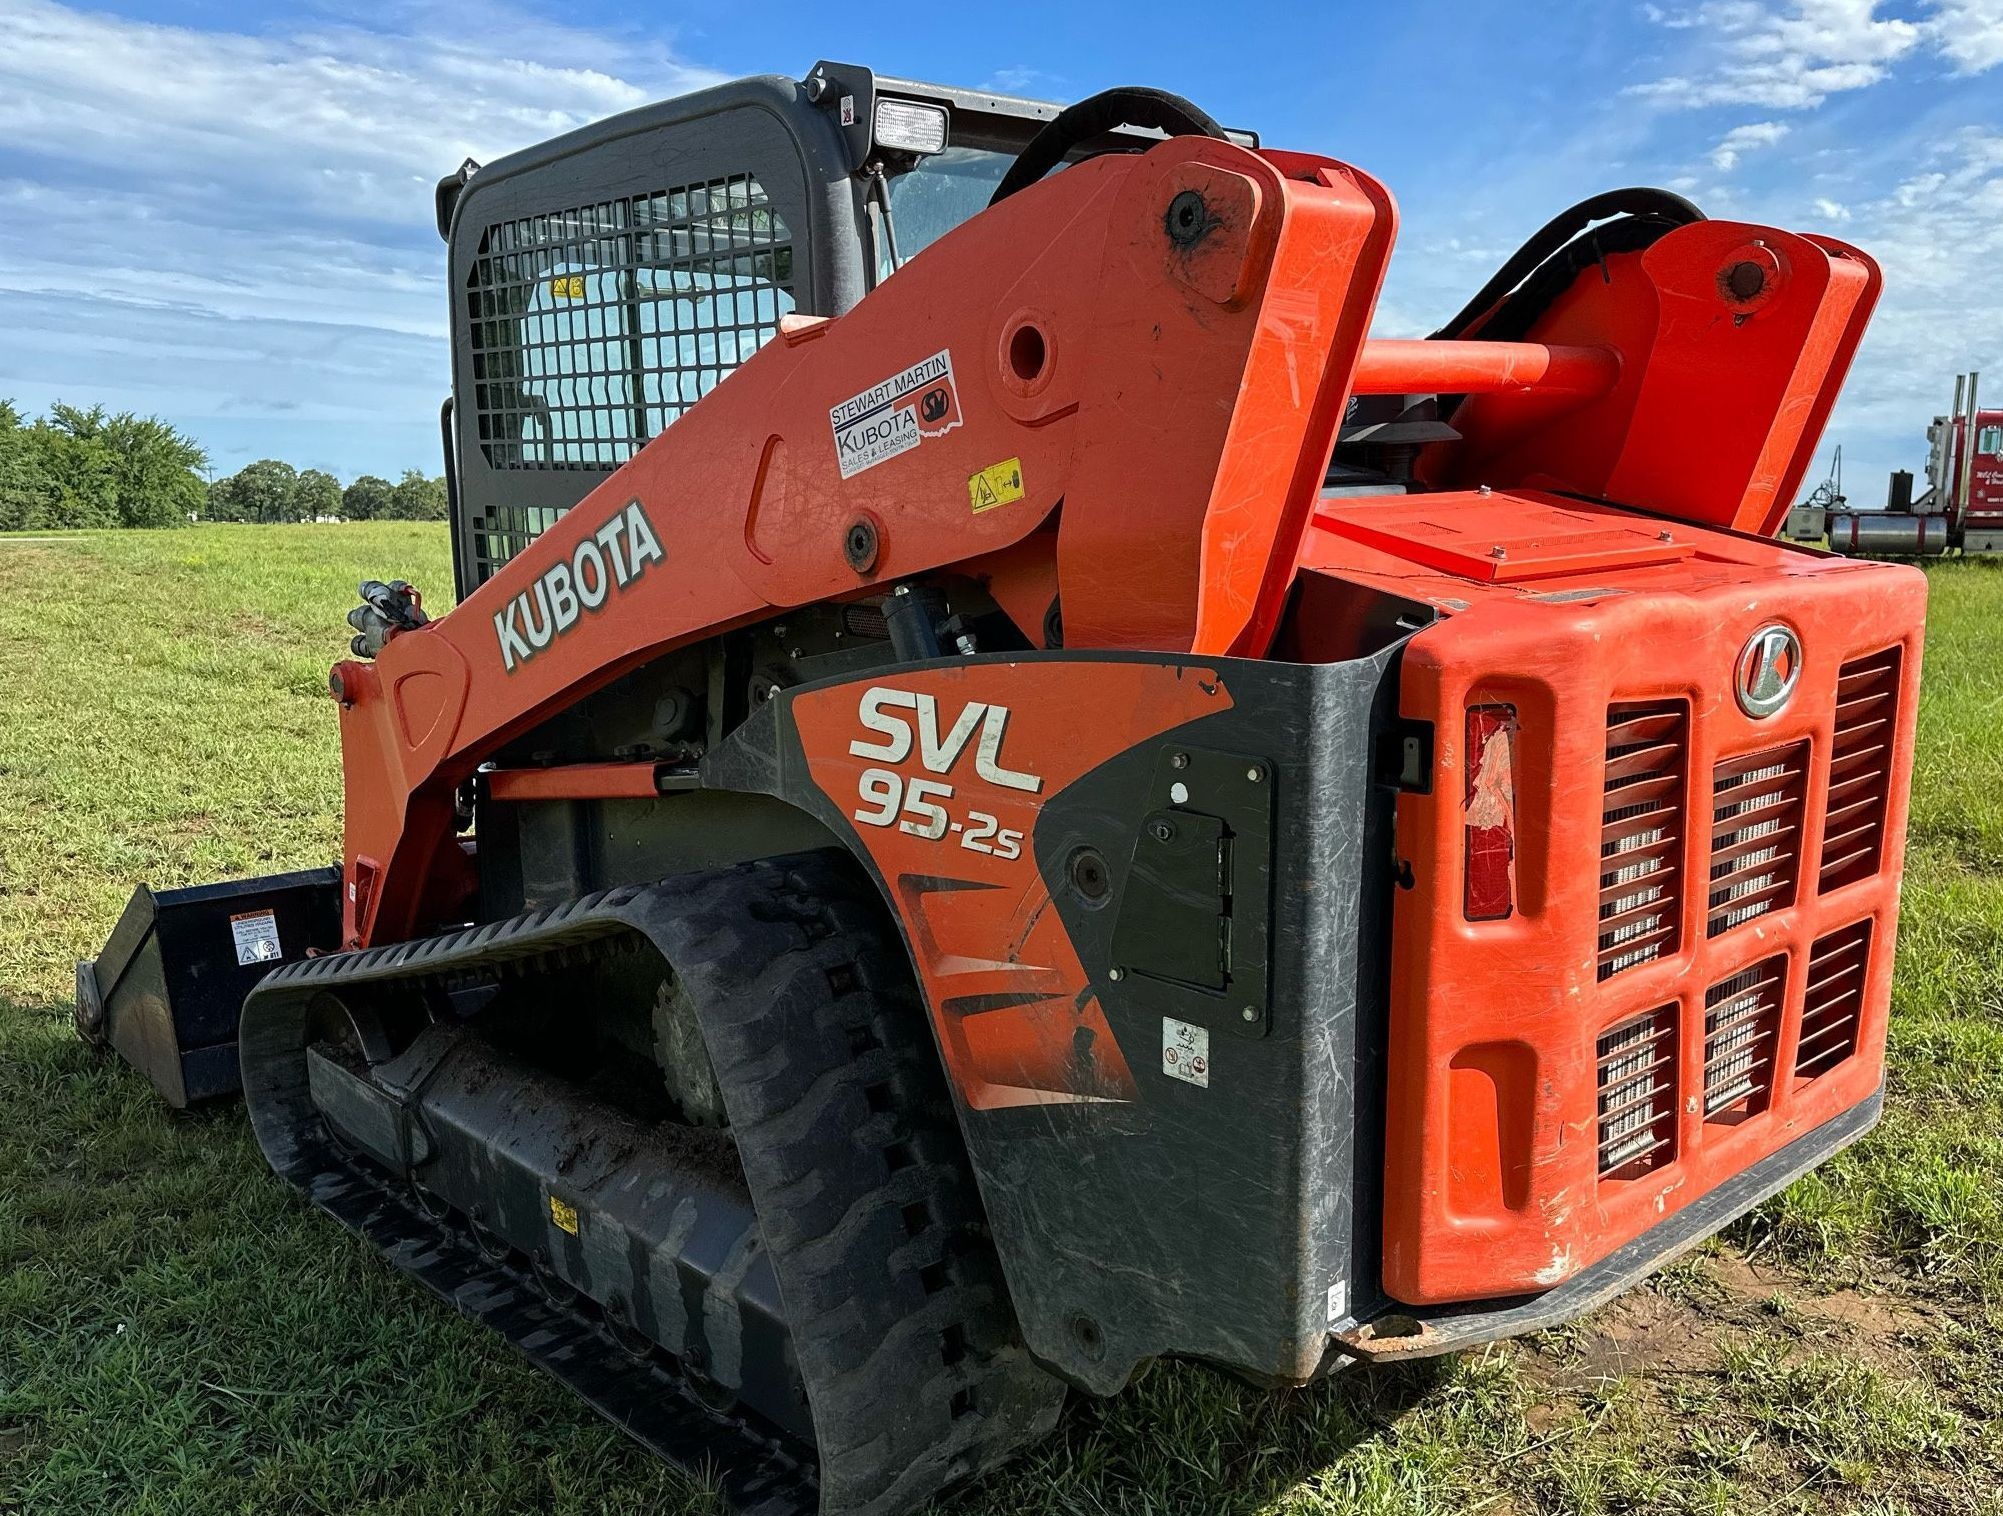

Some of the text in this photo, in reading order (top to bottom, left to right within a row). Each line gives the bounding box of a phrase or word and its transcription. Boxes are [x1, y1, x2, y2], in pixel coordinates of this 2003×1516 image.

[832, 355, 947, 425] STEWART MARTIN
[837, 409, 916, 458] KUBOTA
[842, 451, 869, 470] SALES
[871, 447, 877, 457] &
[879, 429, 917, 453] LEASING
[493, 501, 663, 672] KUBOTA
[849, 687, 1042, 793] SVL
